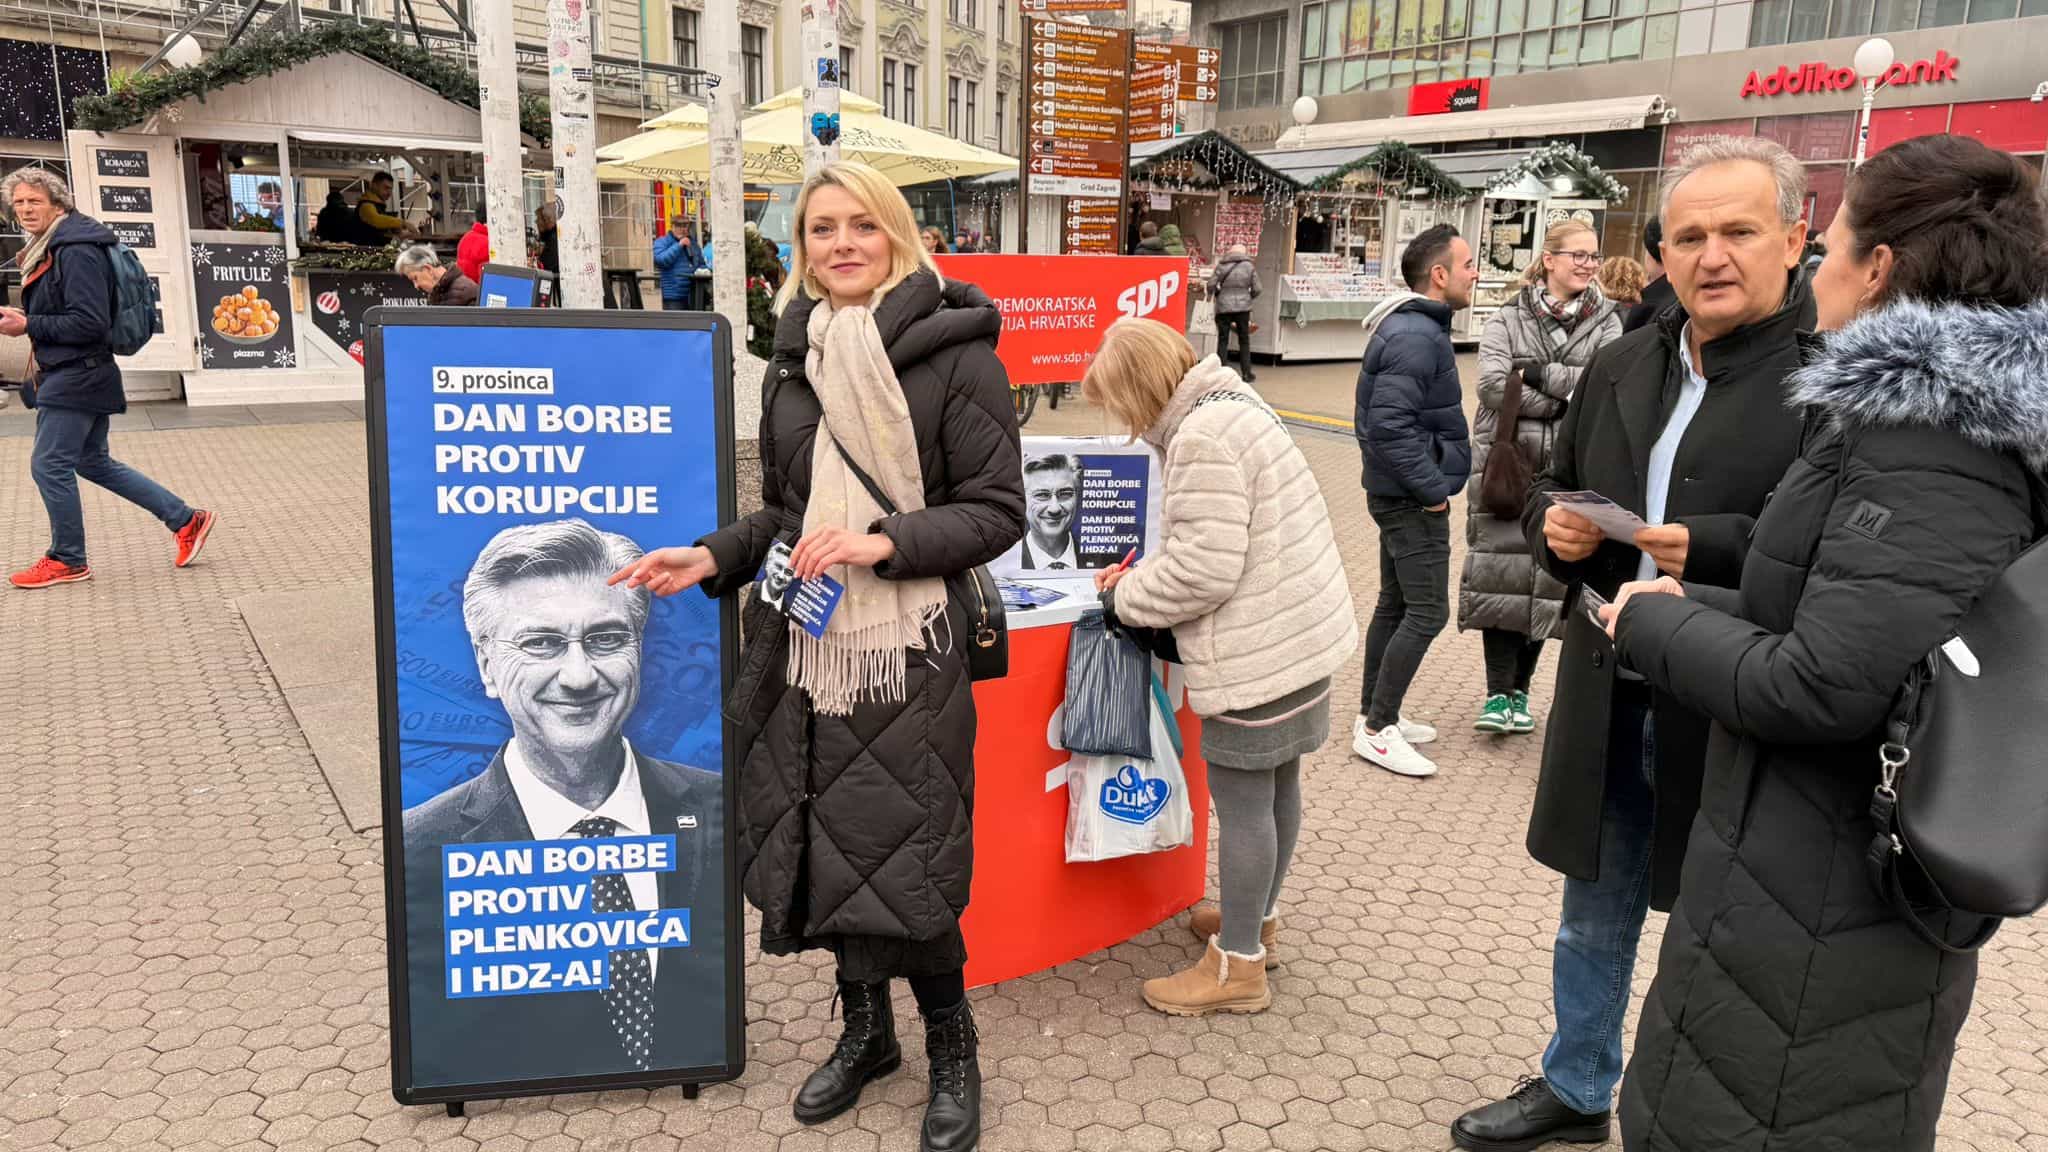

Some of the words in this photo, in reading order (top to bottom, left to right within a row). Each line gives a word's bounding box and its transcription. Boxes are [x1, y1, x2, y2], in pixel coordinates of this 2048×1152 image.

[1740, 62, 1856, 97] Addiko
[1454, 95, 1477, 106] SQUARE
[212, 265, 272, 282] FRITULE
[994, 297, 1096, 313] DEMOKRATSKA
[1117, 271, 1180, 321] SDP
[1001, 315, 1026, 331] TIJA
[1030, 314, 1096, 330] HRVATSKE
[233, 350, 265, 358] plazma
[437, 369, 455, 389] 9.
[462, 371, 549, 394] prosinca
[434, 404, 526, 432] DAN
[537, 404, 672, 434] BORBE
[435, 445, 585, 474] PROTIV
[1082, 490, 1119, 498] PROTIV
[1083, 480, 1105, 488] DAN
[1107, 480, 1141, 488] BORBE
[436, 485, 659, 515] KORUPCIJE
[1082, 500, 1136, 509] KORUPCIJE
[1080, 526, 1115, 534] PROTIV
[1081, 516, 1102, 524] DAN
[1104, 516, 1136, 524] BORBE
[1085, 545, 1118, 553] HDZ-A!
[1105, 784, 1158, 807] Dukt
[448, 848, 533, 879] DAN
[543, 842, 667, 874] BORBE
[449, 884, 586, 917] PROTIV
[450, 911, 688, 955] PLENKOVIĆA
[452, 967, 461, 993] I
[472, 959, 602, 992] HDZ-A!
